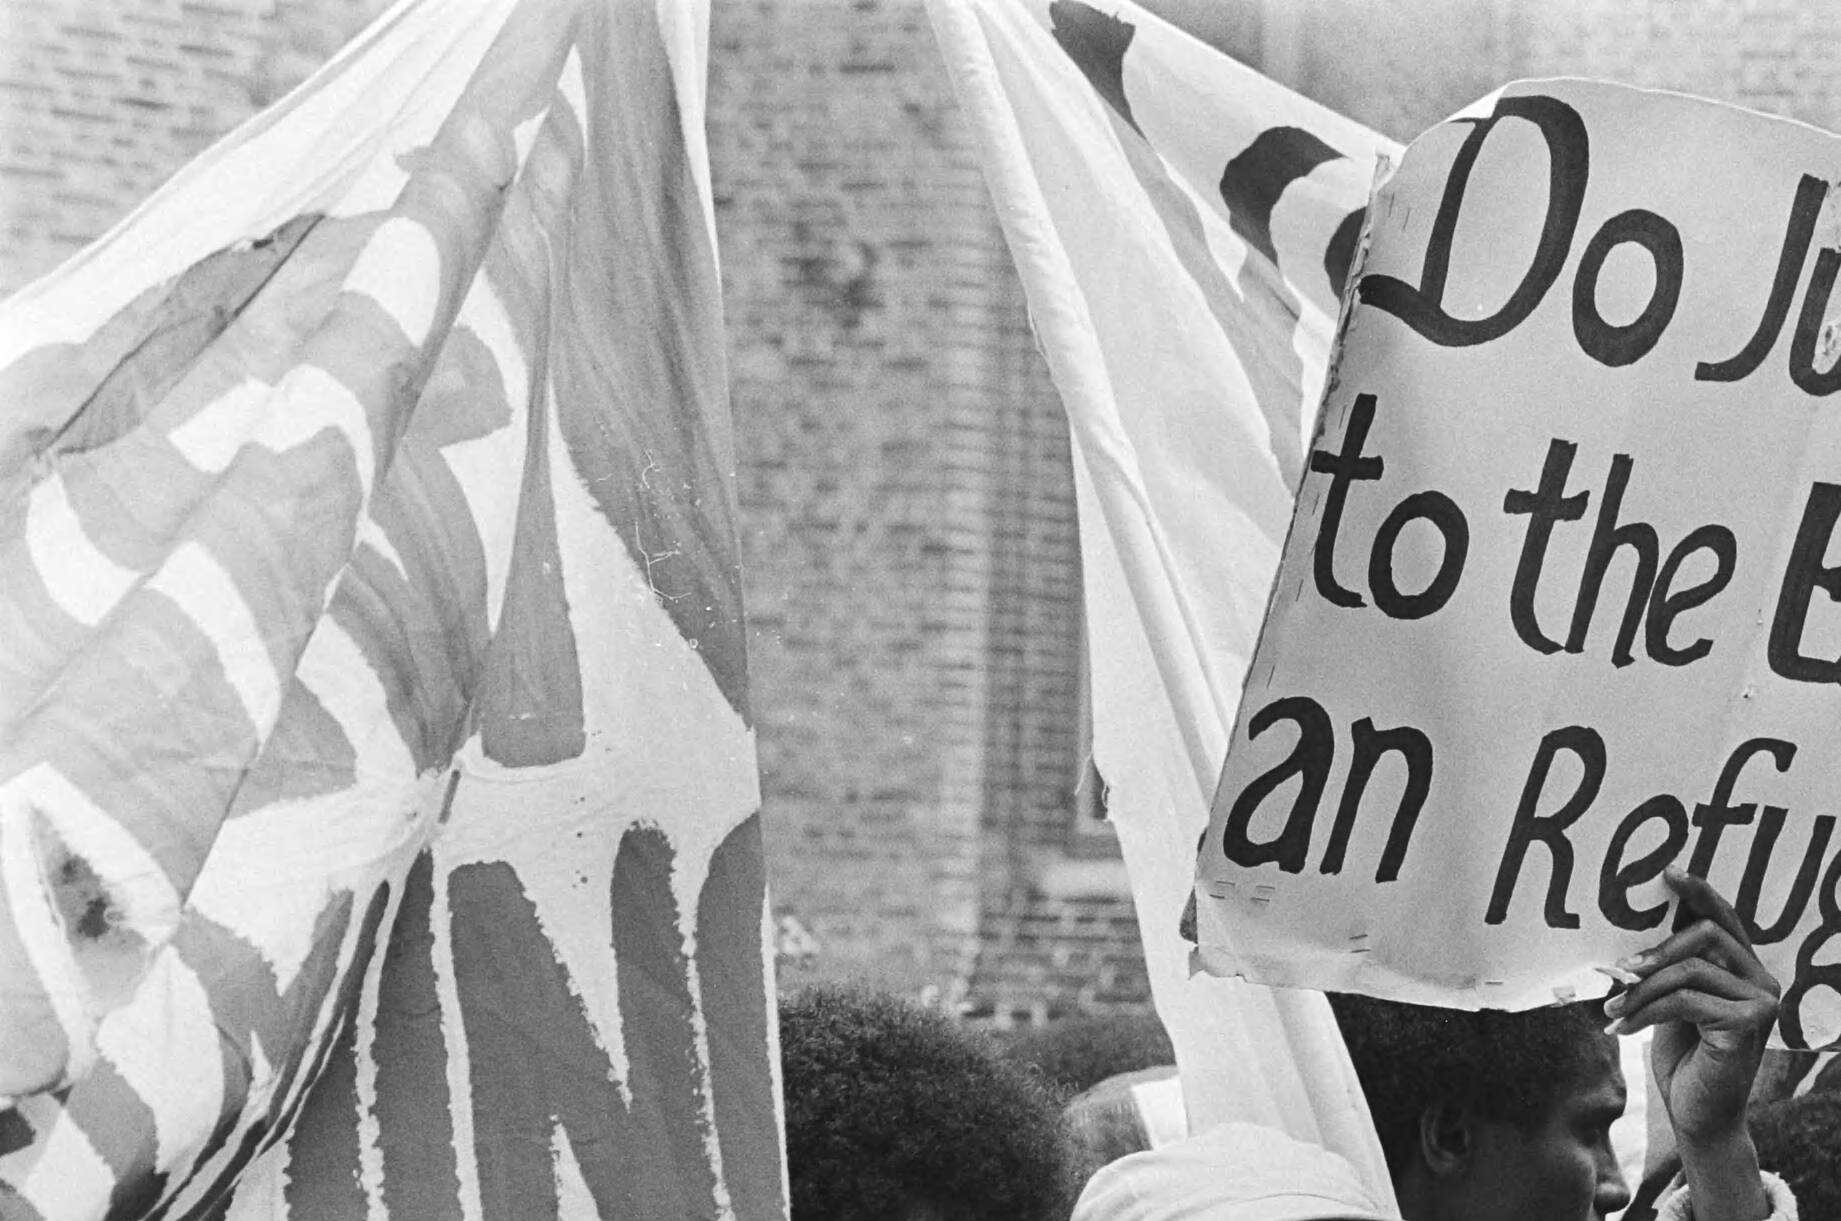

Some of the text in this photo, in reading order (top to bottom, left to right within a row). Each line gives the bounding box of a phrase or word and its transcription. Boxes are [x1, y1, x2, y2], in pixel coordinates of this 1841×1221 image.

[1358, 94, 1684, 368] Do
[1309, 393, 1470, 621] to
[1503, 437, 1738, 670] the
[1221, 695, 1434, 885] an
